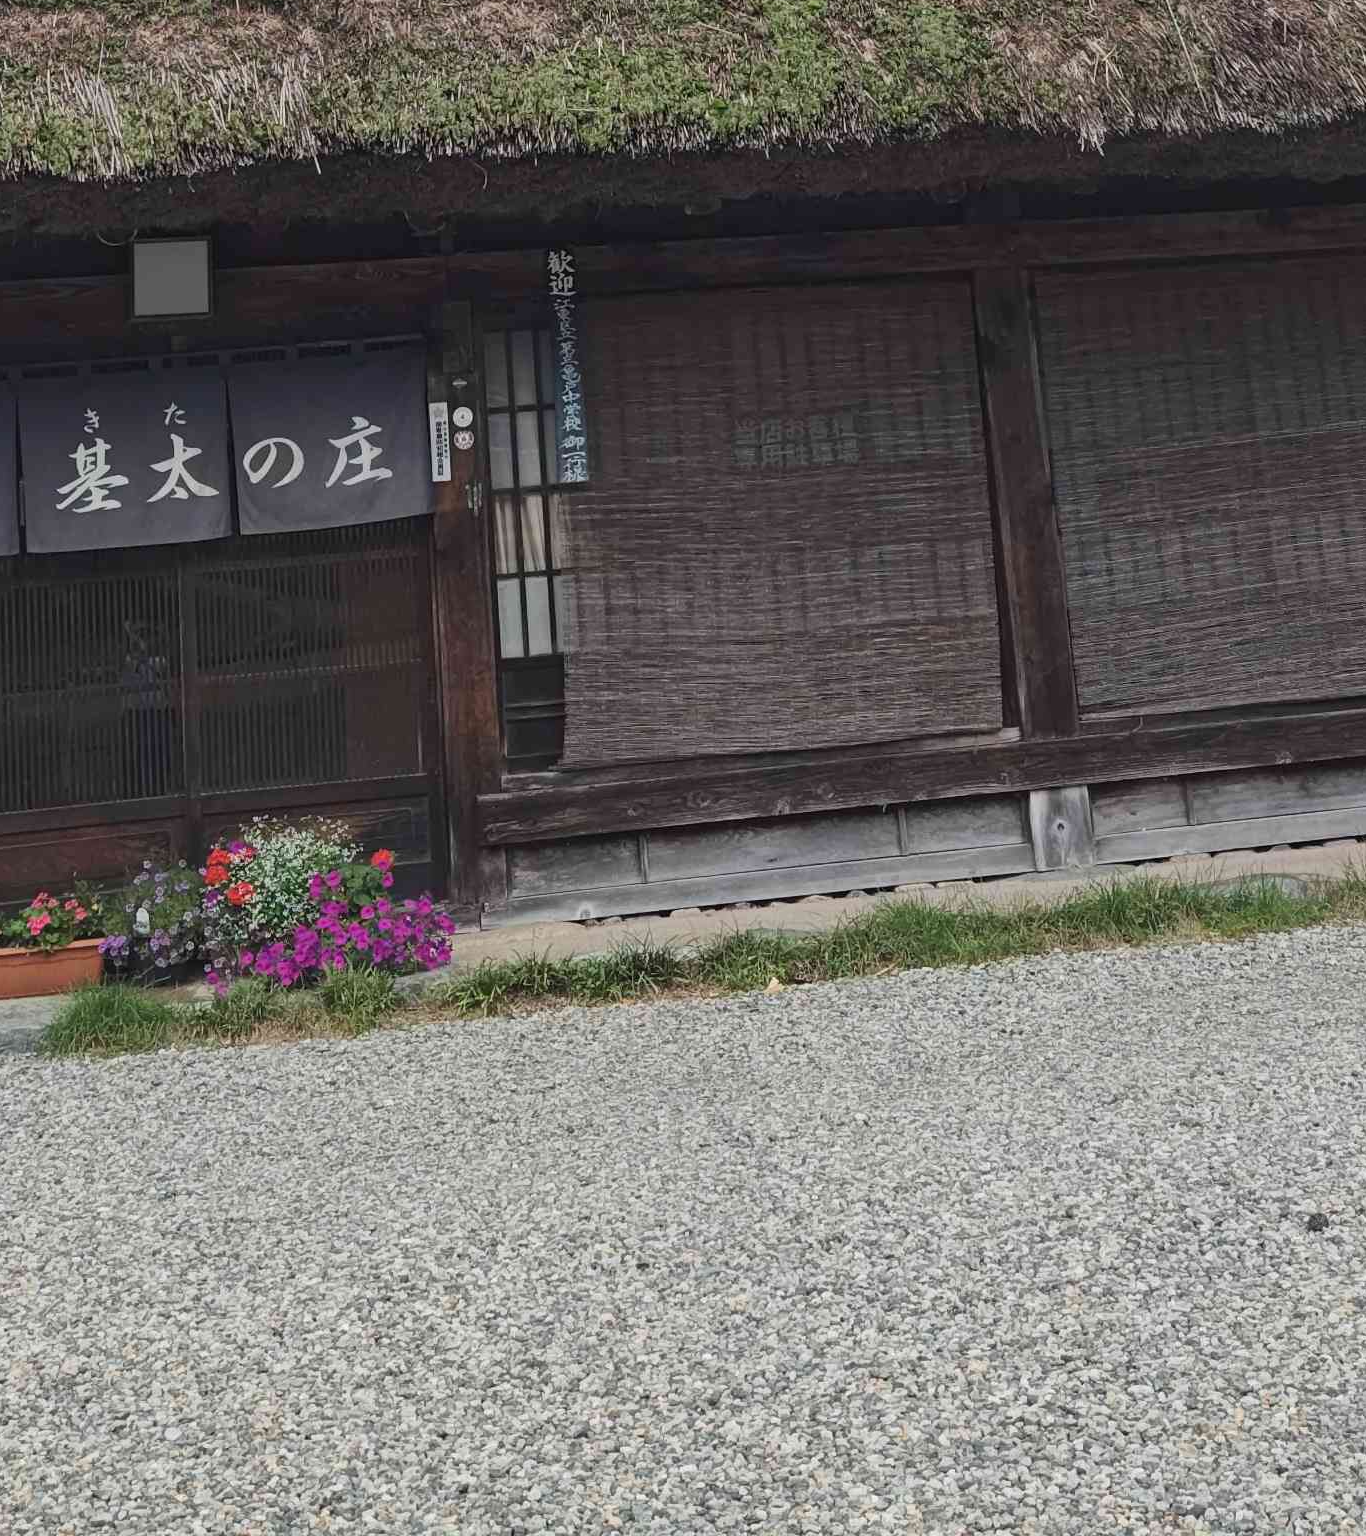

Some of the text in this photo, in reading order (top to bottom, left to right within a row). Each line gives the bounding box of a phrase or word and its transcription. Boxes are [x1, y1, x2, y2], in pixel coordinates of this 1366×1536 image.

[547, 250, 576, 296] 歓迎
[84, 402, 186, 433] きた
[56, 416, 393, 513] 基太の庄
[561, 435, 588, 481] 御一行様
